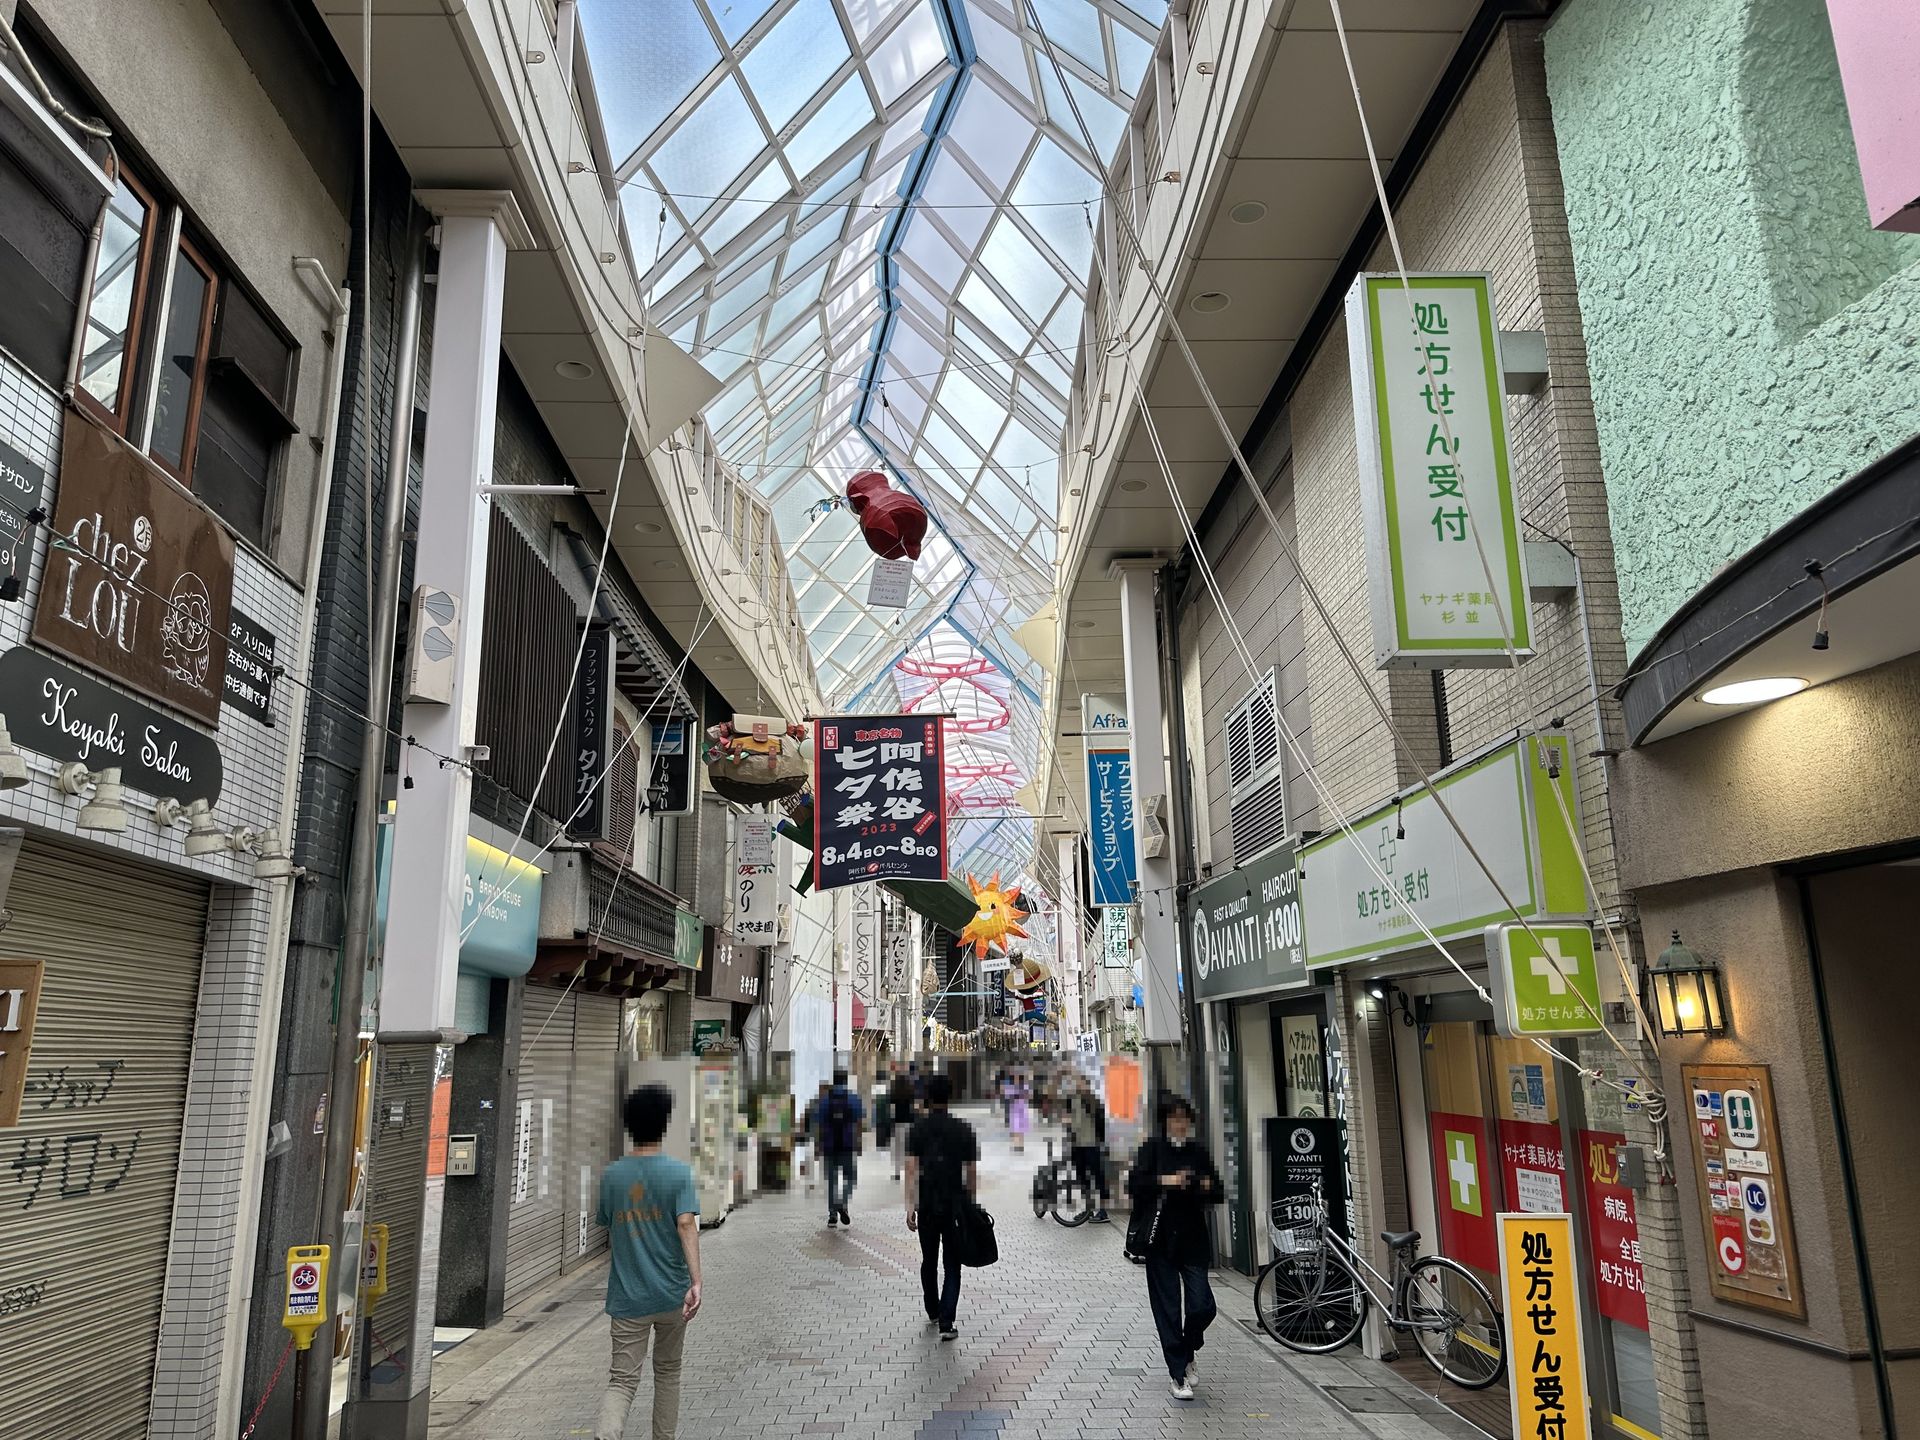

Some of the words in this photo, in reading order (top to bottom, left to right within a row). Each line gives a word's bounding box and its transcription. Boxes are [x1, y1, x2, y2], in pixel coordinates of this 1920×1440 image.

[1412, 302, 1469, 542] 処方せん受付
[41, 677, 126, 760] Keyaki
[140, 724, 193, 784] Salon
[879, 741, 926, 820] 阿佐谷
[576, 748, 598, 819] タカノ
[834, 745, 878, 828] 七夕祭
[861, 822, 898, 837] 2023
[1213, 906, 1225, 923] FAST
[1229, 895, 1249, 917] QUALITY
[1261, 868, 1297, 904] HAIRCUT
[1357, 867, 1429, 919] 処方せん受付
[736, 920, 774, 934] さやま園
[1211, 914, 1262, 972] AVANTI
[1264, 900, 1301, 953] ¥1300
[852, 922, 873, 999] Jewelry
[1289, 1029, 1317, 1051] ヘアカット
[11, 1130, 142, 1210] サロン
[1287, 1154, 1322, 1162] AVANTI
[1504, 1142, 1566, 1170] ヤナギ薬局杉並
[1747, 1190, 1765, 1206] UC
[1520, 1230, 1567, 1440] 処方せん受付
